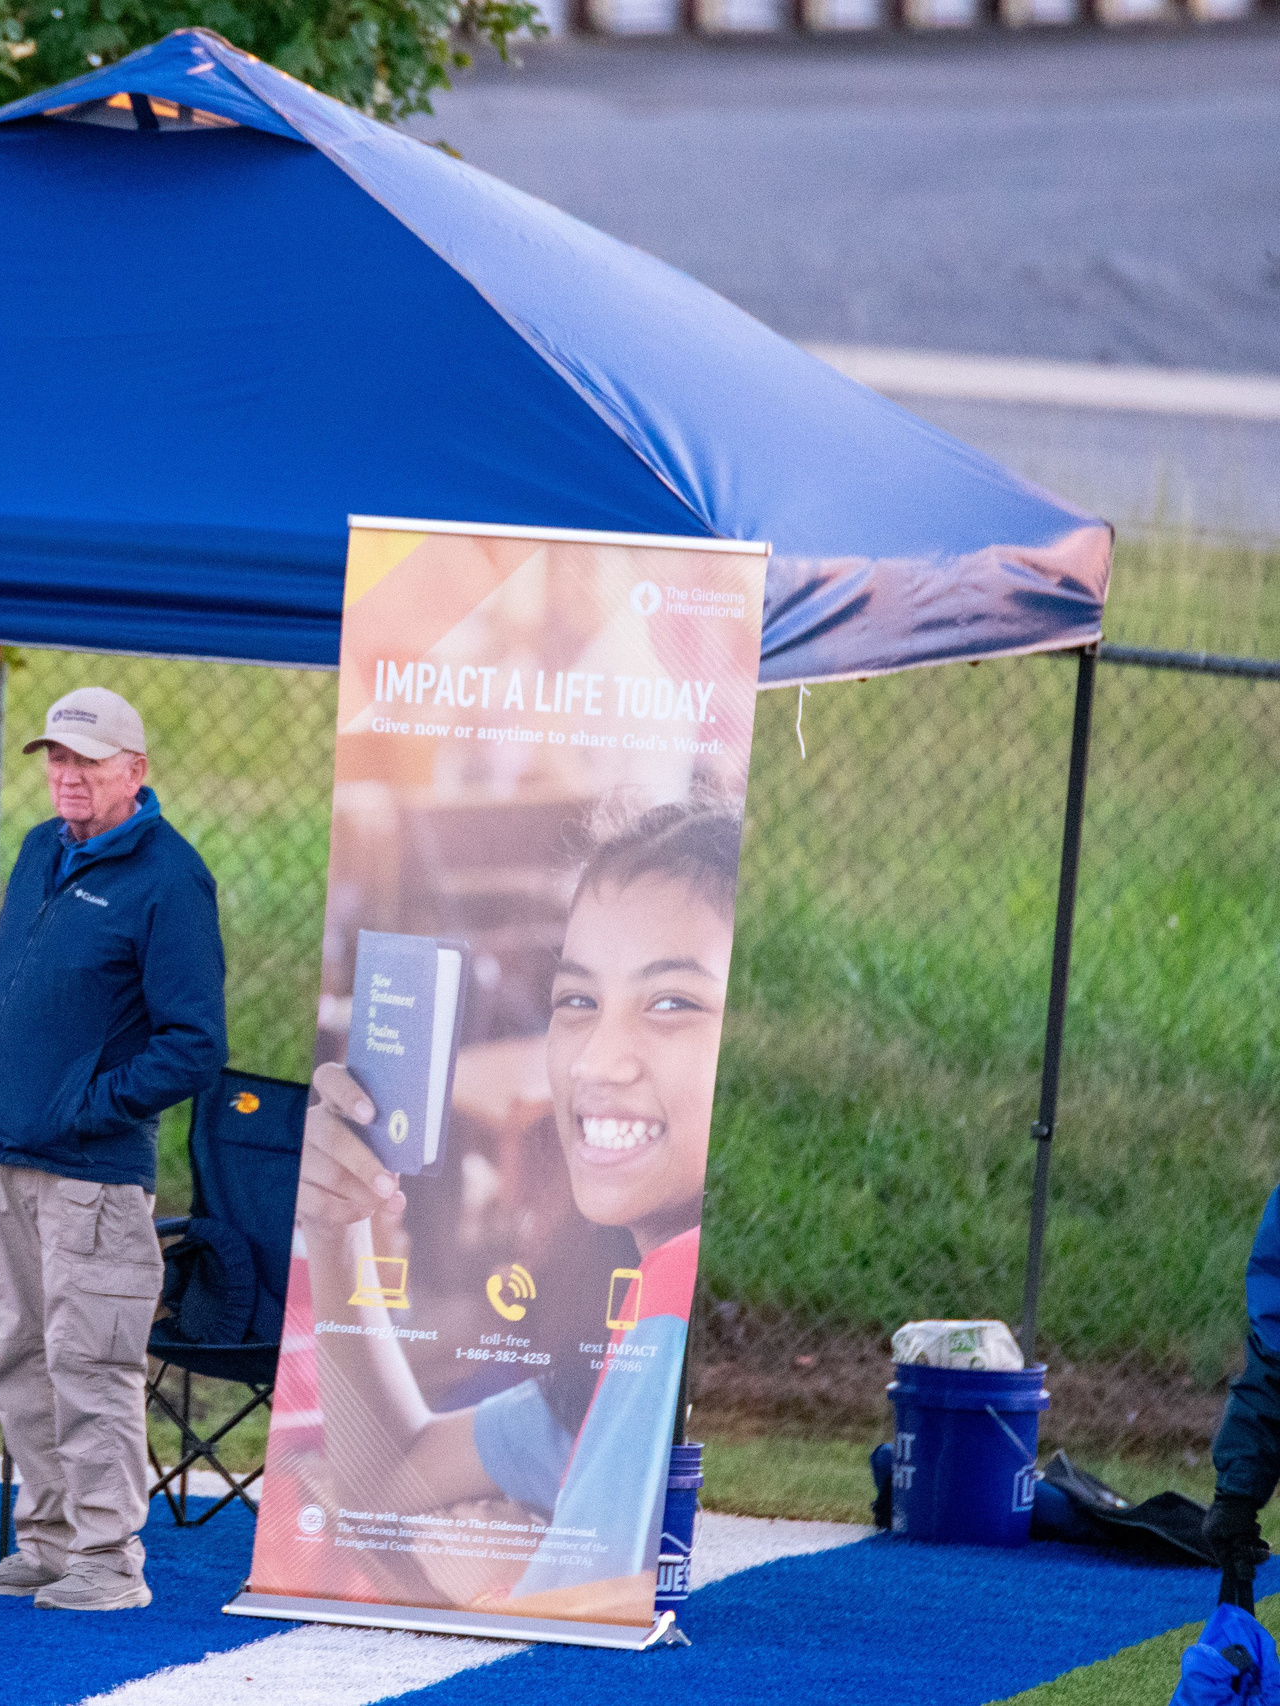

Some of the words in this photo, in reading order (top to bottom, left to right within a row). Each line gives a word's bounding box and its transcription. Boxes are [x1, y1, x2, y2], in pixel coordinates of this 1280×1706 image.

[666, 586, 688, 600] The
[691, 588, 745, 604] Gideons
[666, 601, 744, 619] International
[375, 660, 498, 709] IMPACT
[503, 668, 524, 711] A
[535, 670, 605, 716] LIFE
[614, 676, 716, 724] TODAY.
[371, 717, 410, 734] Give
[414, 722, 450, 737] now
[454, 725, 473, 739] or
[477, 725, 543, 746] anytime
[548, 730, 566, 743] to
[570, 730, 617, 748] share
[622, 734, 667, 750] God's
[314, 1320, 438, 1342] gideons.org/impact
[480, 1333, 530, 1348] toll-free
[455, 1347, 551, 1366] 1-866-382-4253
[579, 1342, 603, 1354] text
[606, 1342, 659, 1358] IMPACT
[590, 1358, 603, 1370] to
[338, 1508, 374, 1520] Donate
[376, 1511, 398, 1522] with
[400, 1513, 454, 1526] confidence
[455, 1518, 467, 1528] to
[469, 1518, 487, 1529] The
[489, 1520, 529, 1532] Gideons
[337, 1522, 355, 1533] The
[357, 1524, 397, 1537] Gideons
[399, 1527, 461, 1541] International
[486, 1535, 537, 1548] accredited
[334, 1536, 388, 1551] Evangelical
[389, 1540, 426, 1553] Council
